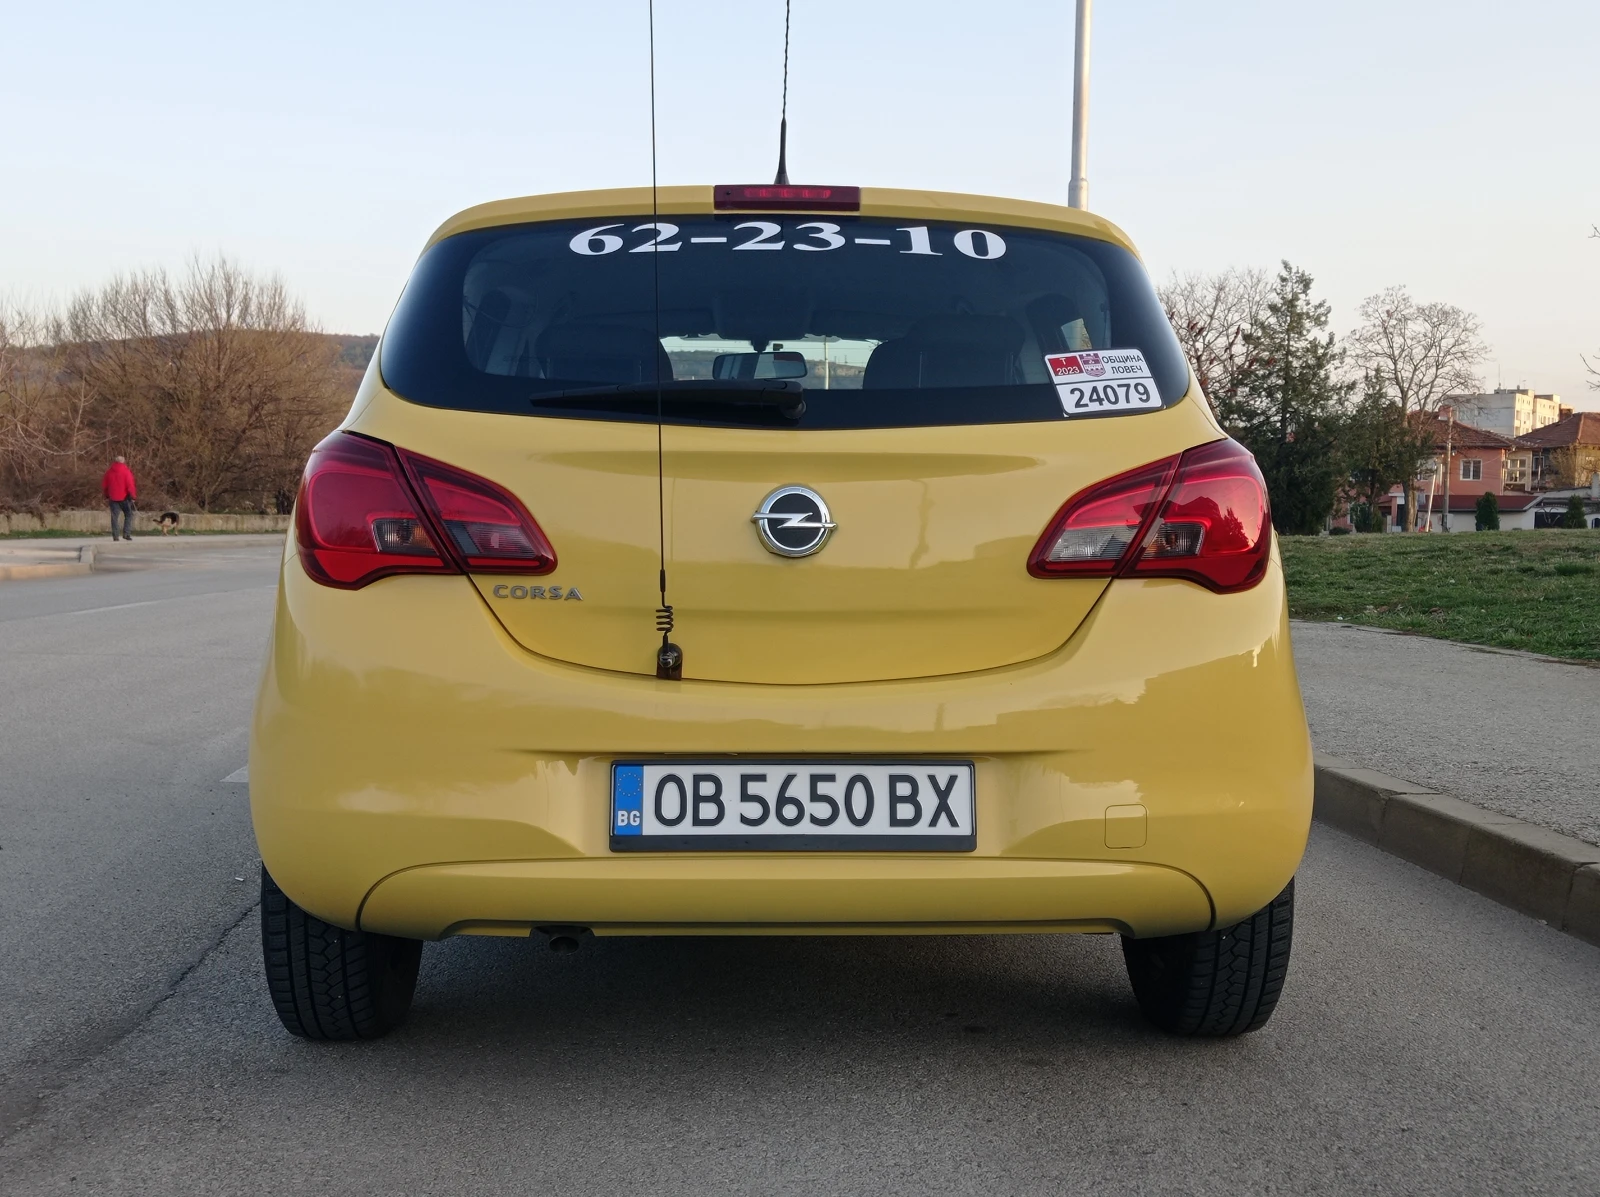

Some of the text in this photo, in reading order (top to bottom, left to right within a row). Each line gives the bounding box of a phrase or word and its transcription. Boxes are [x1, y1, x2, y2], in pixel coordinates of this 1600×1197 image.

[569, 222, 1007, 260] 62-23-10
[1101, 355, 1145, 364] ОБЩИНА
[1056, 366, 1081, 376] 2023
[1111, 365, 1144, 375] ЛОВЕЧ
[1069, 382, 1151, 409] 24079
[493, 584, 583, 601] CORSA
[739, 773, 875, 827] 5650
[617, 810, 641, 826] BG
